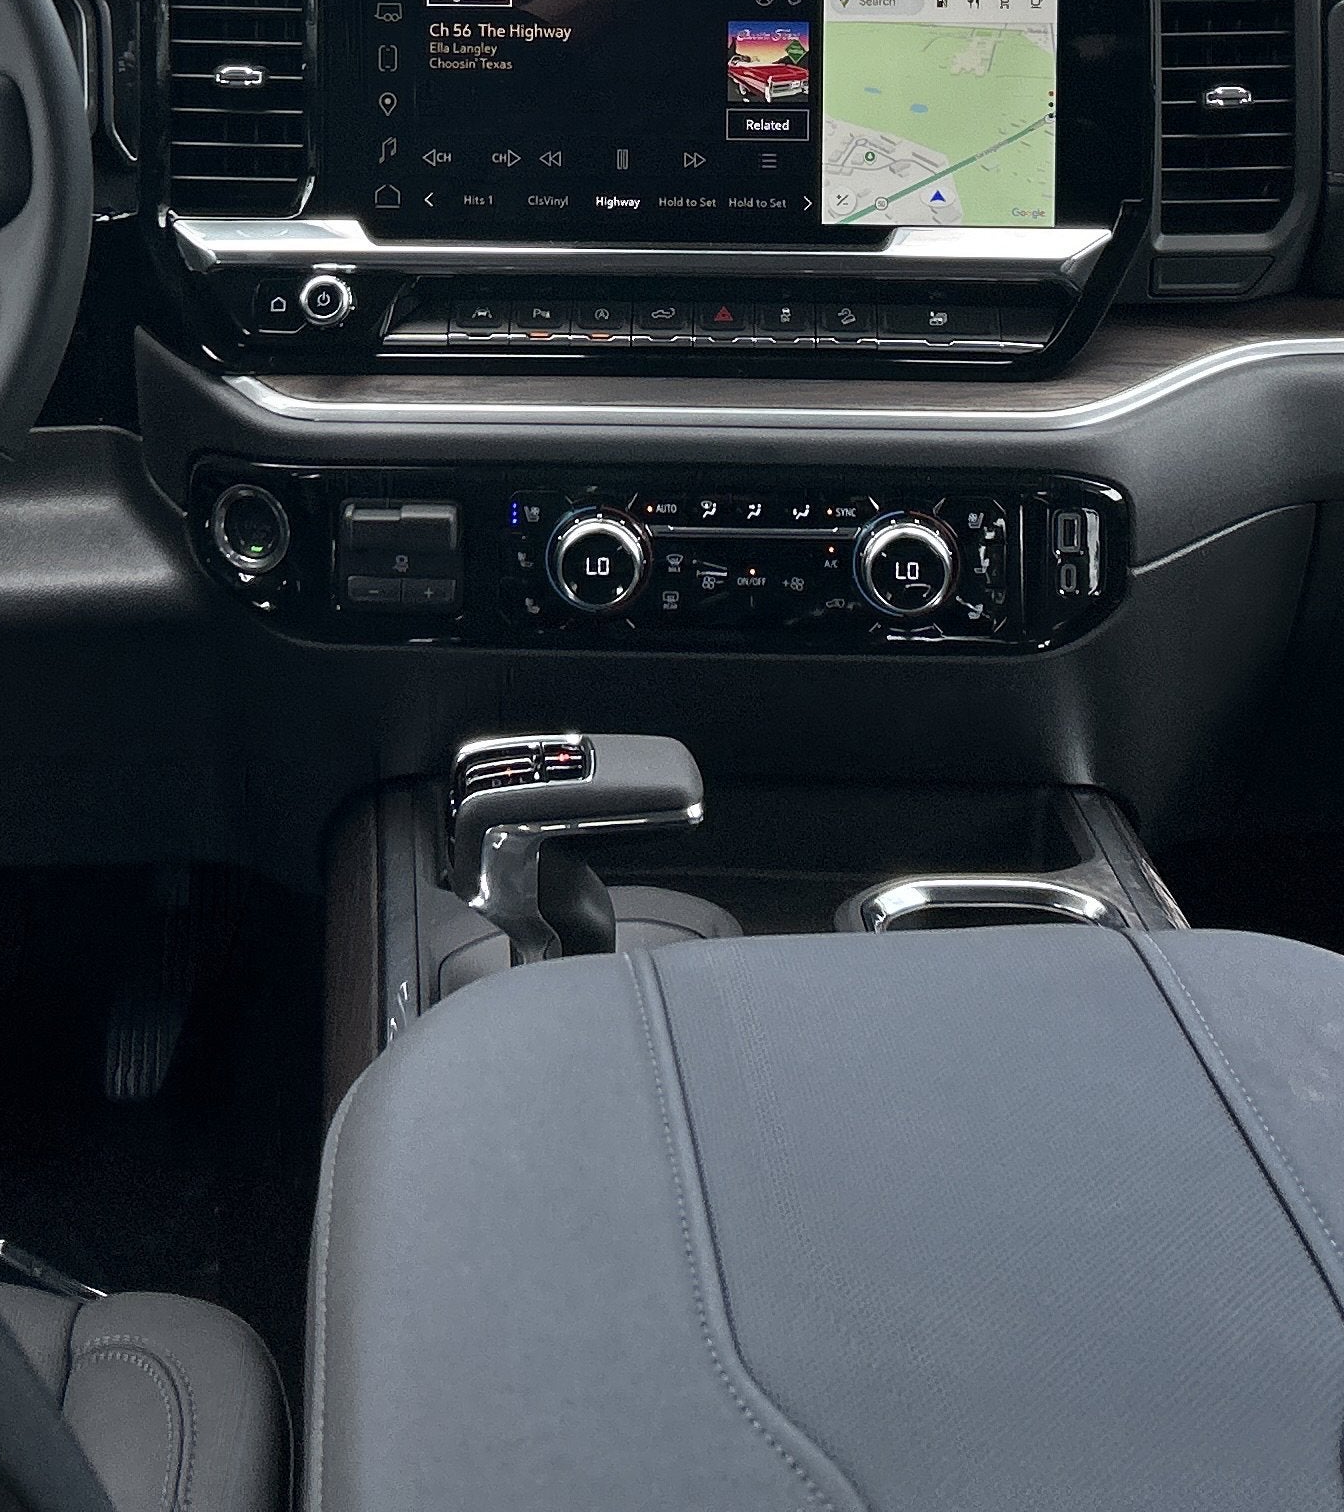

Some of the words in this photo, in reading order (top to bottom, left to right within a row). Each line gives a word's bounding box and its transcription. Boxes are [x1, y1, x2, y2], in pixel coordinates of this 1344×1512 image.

[430, 22, 449, 37] Ch
[453, 24, 472, 37] 56
[478, 23, 505, 38] The
[509, 23, 572, 42] Highway
[430, 42, 450, 53] Ella
[453, 42, 498, 56] Langley
[429, 58, 479, 69] Choosin'
[480, 58, 513, 70] Texas
[746, 119, 790, 130] Related
[436, 152, 452, 163] CH
[492, 152, 507, 163] CH
[464, 195, 485, 206] Hits
[488, 195, 493, 205] 1
[528, 196, 569, 208] ClsVinyl
[595, 196, 641, 210] Highway
[658, 197, 683, 207] Hold
[686, 198, 697, 207] to
[700, 198, 716, 207] Set
[729, 198, 753, 208] Hold
[756, 199, 767, 208] to
[769, 199, 786, 208] Set
[1012, 208, 1046, 220] Google
[656, 504, 677, 513] AUTO
[836, 508, 856, 518] SYNC
[586, 557, 610, 576] LO
[824, 560, 838, 569] A/C
[896, 562, 919, 580] LO
[737, 577, 766, 586] ON/OFF
